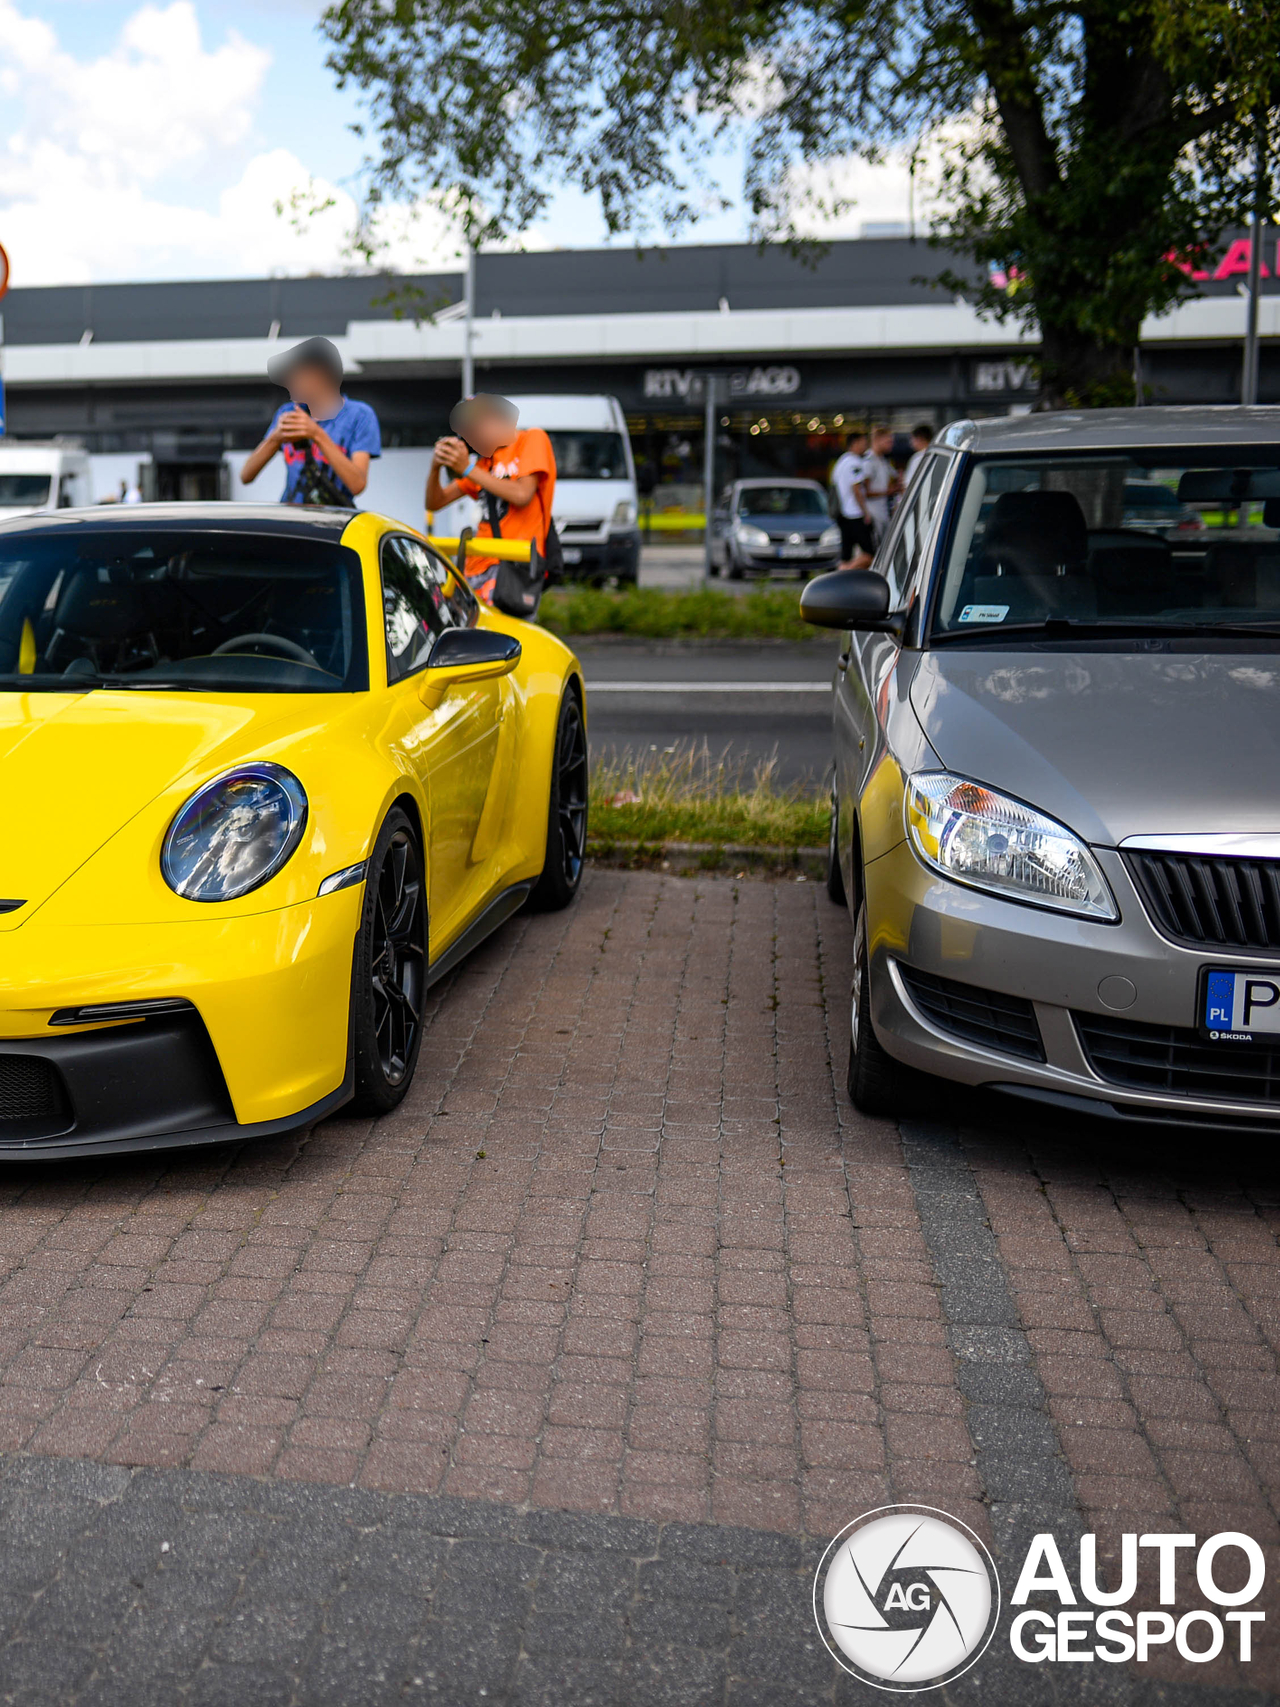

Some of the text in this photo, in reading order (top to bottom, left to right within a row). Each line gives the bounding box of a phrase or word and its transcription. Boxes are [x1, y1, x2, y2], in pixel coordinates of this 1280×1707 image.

[644, 369, 693, 397] RTV
[1209, 1007, 1229, 1021] PL
[1242, 979, 1280, 1026] P
